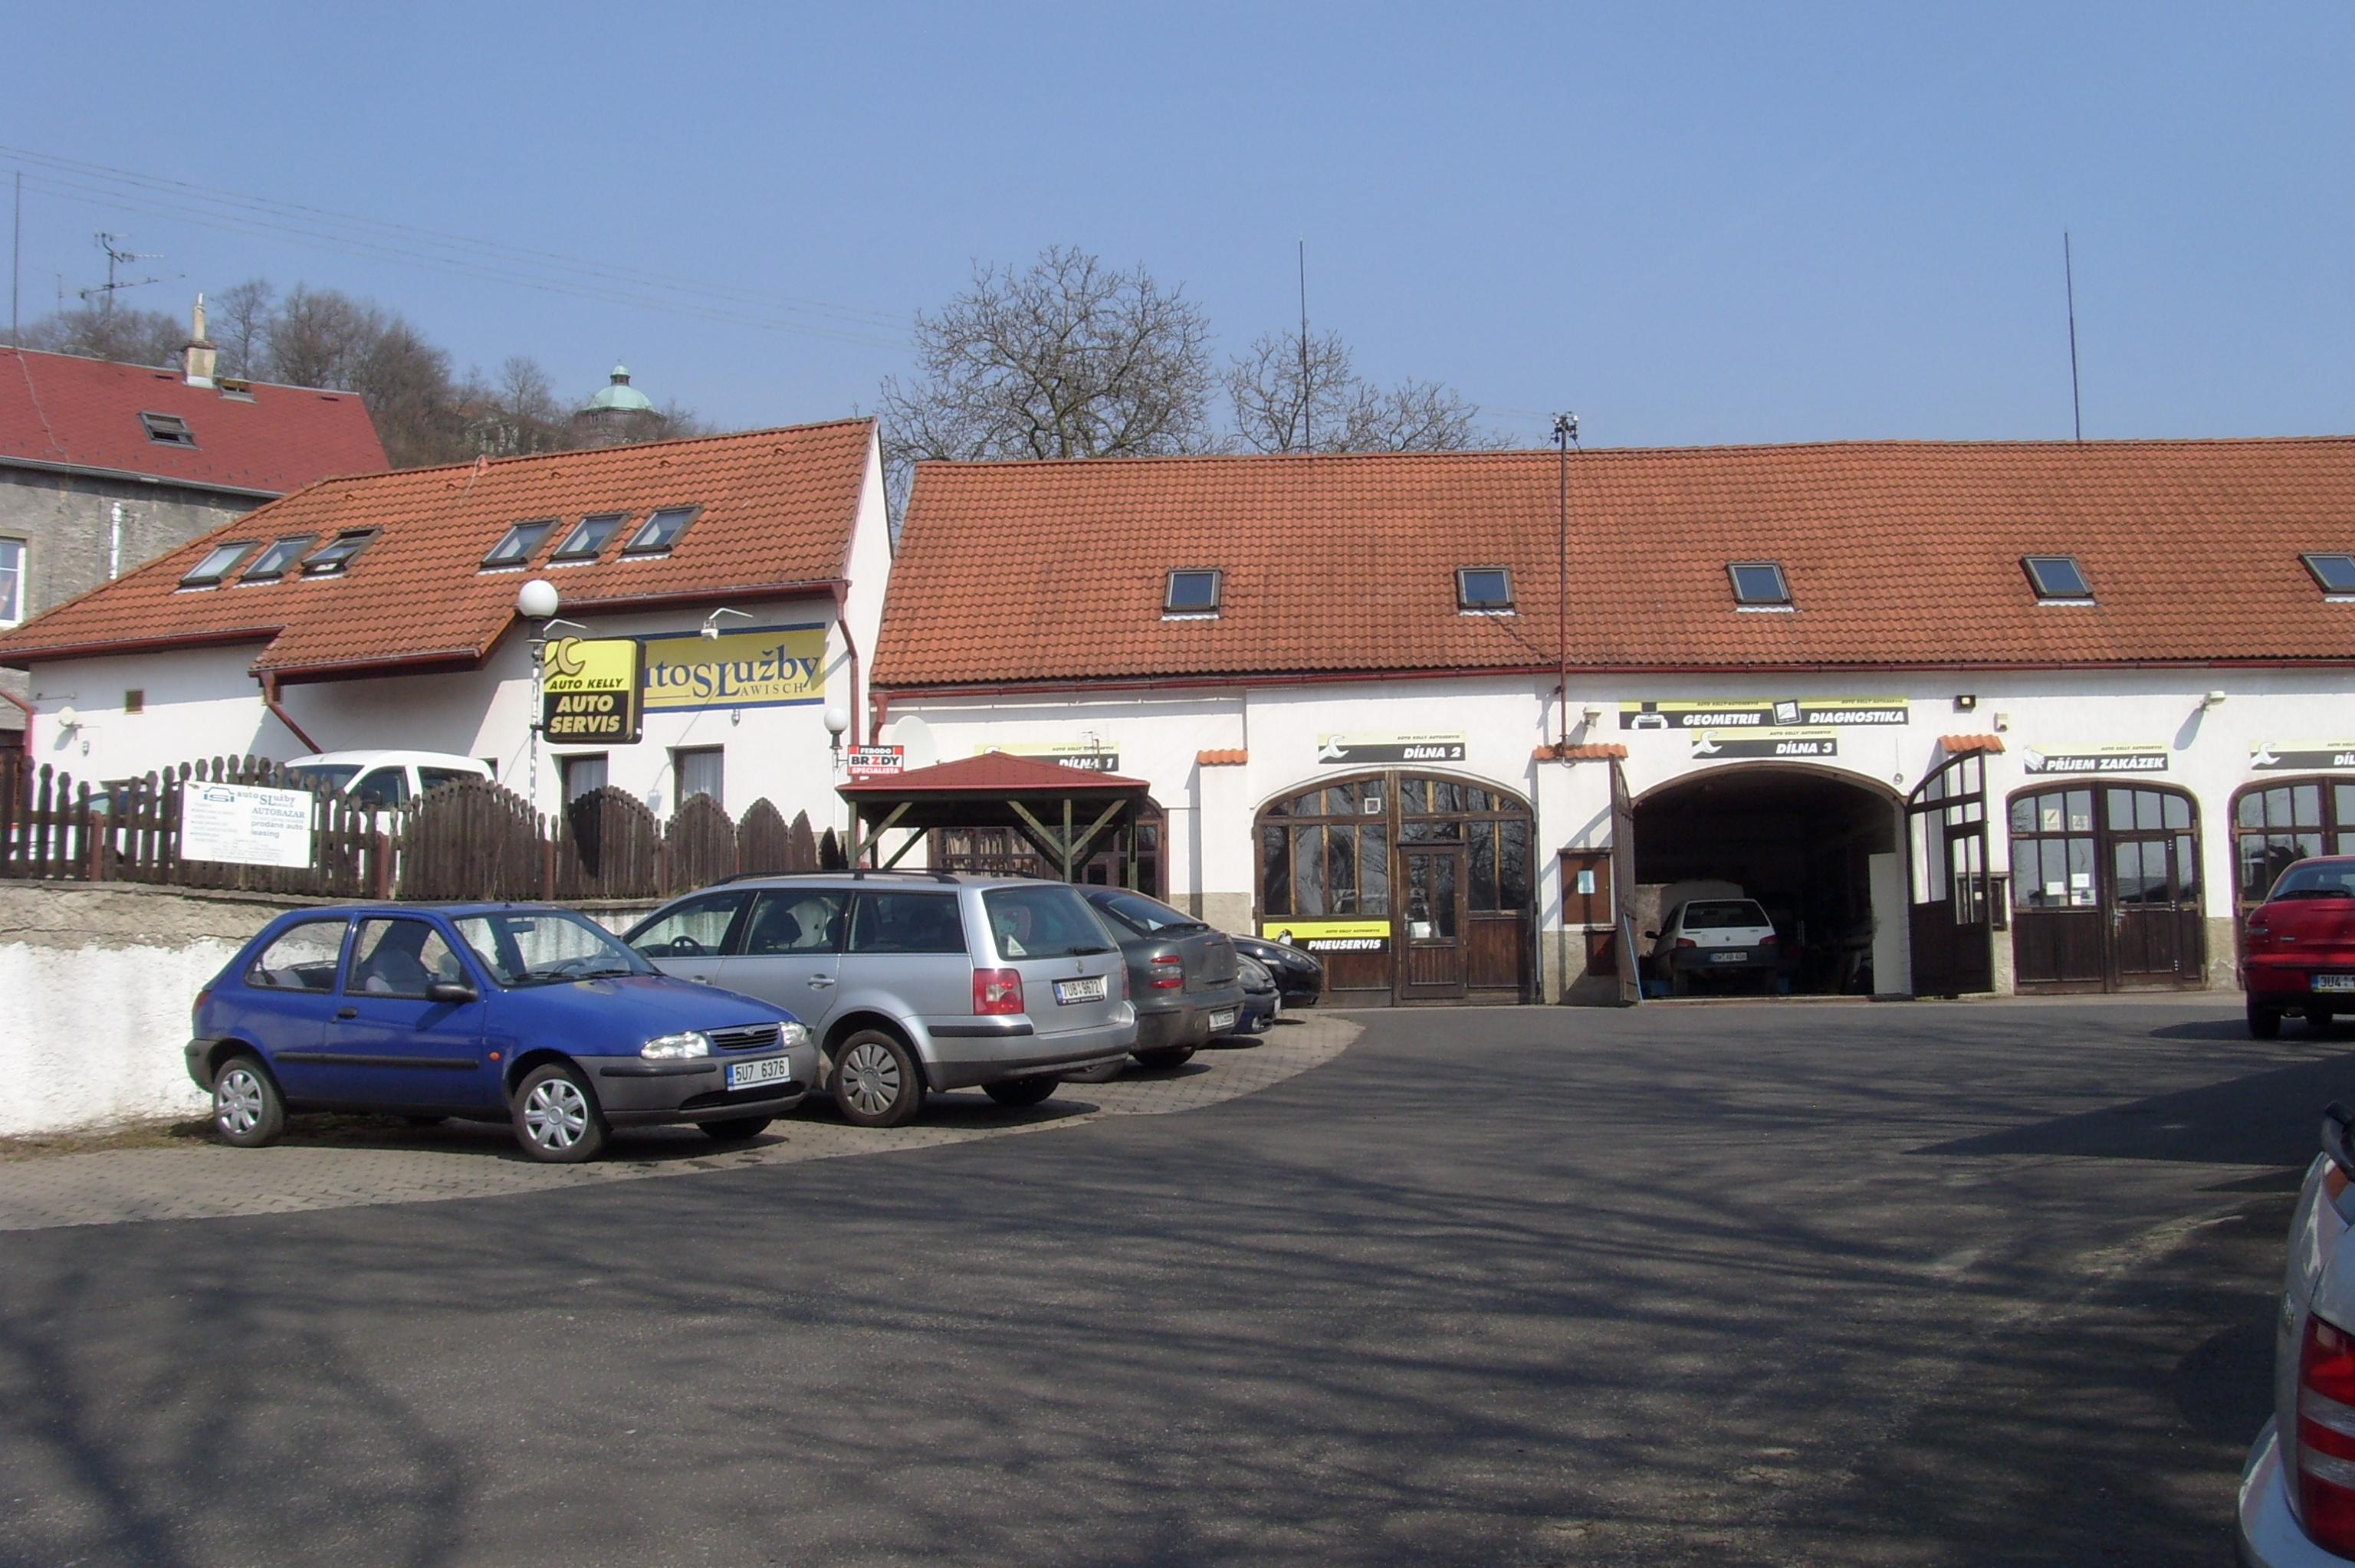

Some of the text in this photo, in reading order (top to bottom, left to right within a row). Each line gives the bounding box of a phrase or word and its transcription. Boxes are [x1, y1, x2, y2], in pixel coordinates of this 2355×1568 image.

[644, 645, 821, 697] toSLužby
[550, 678, 624, 690] AUTO KELLY
[556, 694, 614, 713] AUTO
[1683, 713, 1761, 726] GEOMETRIE
[1809, 711, 1905, 723] DIAGNOSTIKA
[549, 715, 620, 733] SERVIS
[1403, 744, 1461, 759] DÍLNA 2
[1775, 740, 1833, 754] DÍLNA 3
[851, 756, 900, 766] BRZDY
[1106, 758, 1114, 769] 1
[2046, 756, 2166, 771] PŘÍJEM ZAKÁZEK
[251, 807, 305, 818] AUTOBAZAR
[1307, 939, 1381, 950] PNEUSERVIS
[2320, 976, 2340, 987] 3U4
[736, 1060, 784, 1081] 5U7 6376
